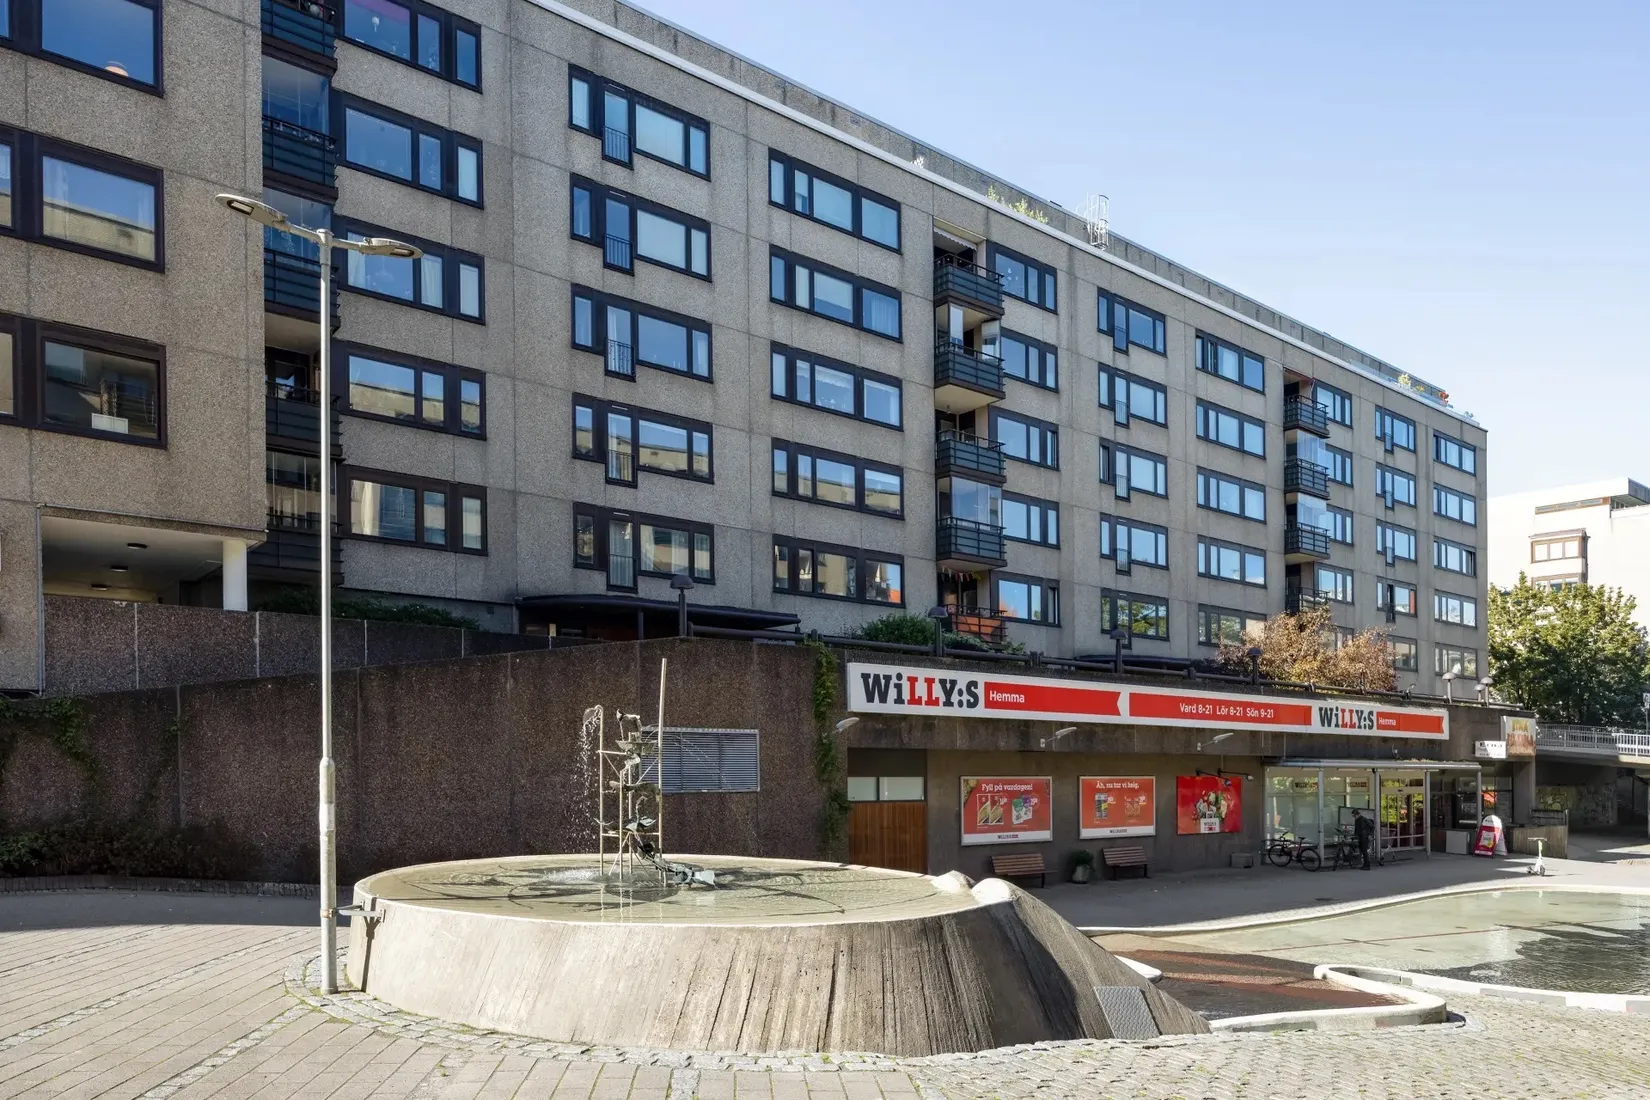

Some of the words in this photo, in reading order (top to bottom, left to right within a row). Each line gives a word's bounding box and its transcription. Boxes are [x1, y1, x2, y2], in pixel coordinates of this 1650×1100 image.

[989, 690, 1025, 703] Hemma
[1179, 702, 1197, 714] Vard
[1198, 704, 1213, 715] 8-21
[1216, 704, 1229, 716] Lör
[1229, 706, 1243, 717] 8-21
[1246, 706, 1260, 718] Sön
[1260, 708, 1274, 719] 9-21
[1378, 716, 1396, 726] Hemma
